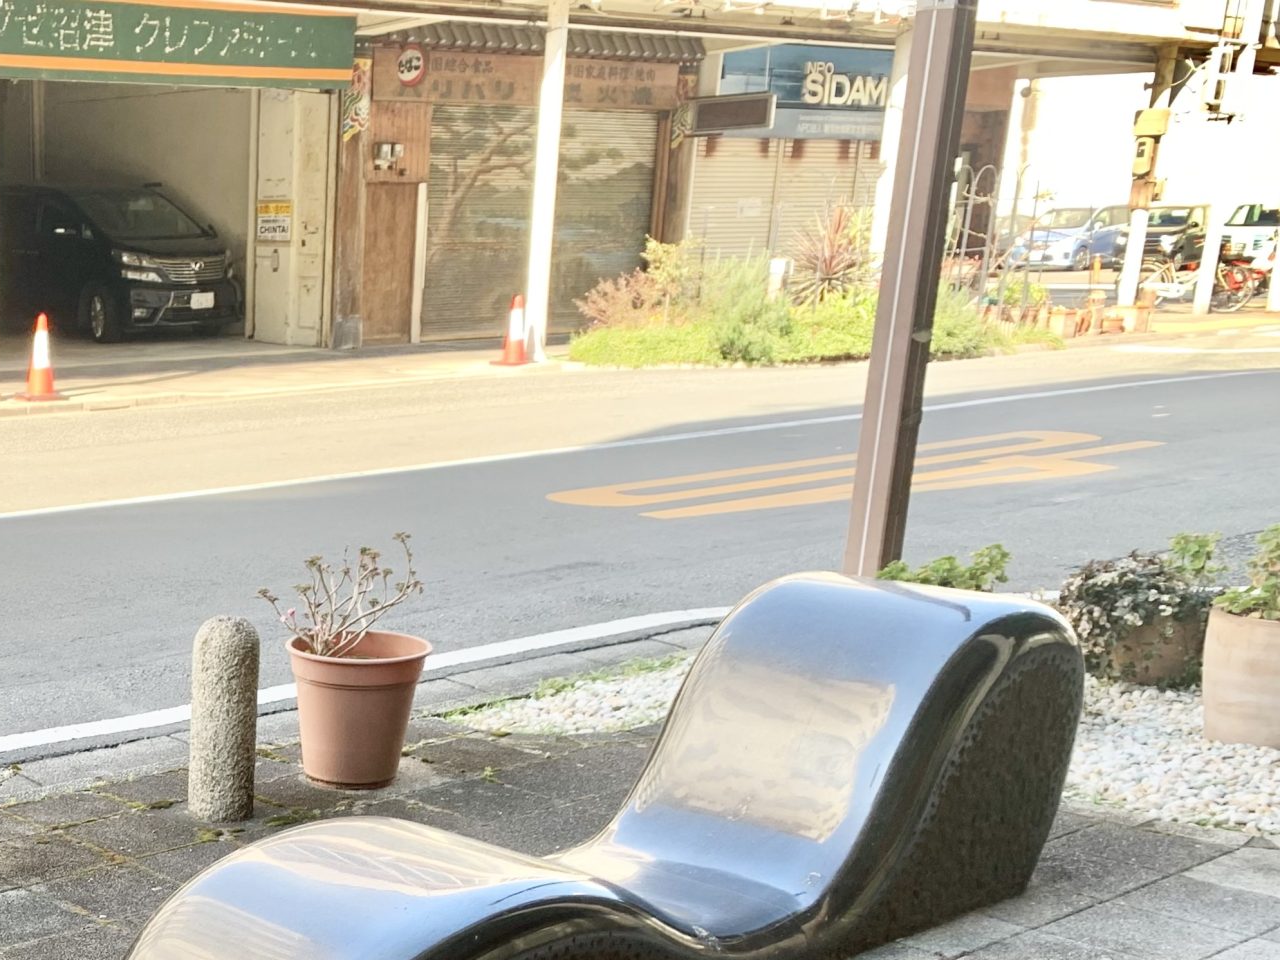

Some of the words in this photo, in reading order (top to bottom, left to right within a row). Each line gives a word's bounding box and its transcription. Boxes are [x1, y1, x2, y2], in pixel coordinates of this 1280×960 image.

[399, 56, 421, 74] たばこ
[805, 61, 835, 75] NPO
[803, 72, 888, 106] SIDAM
